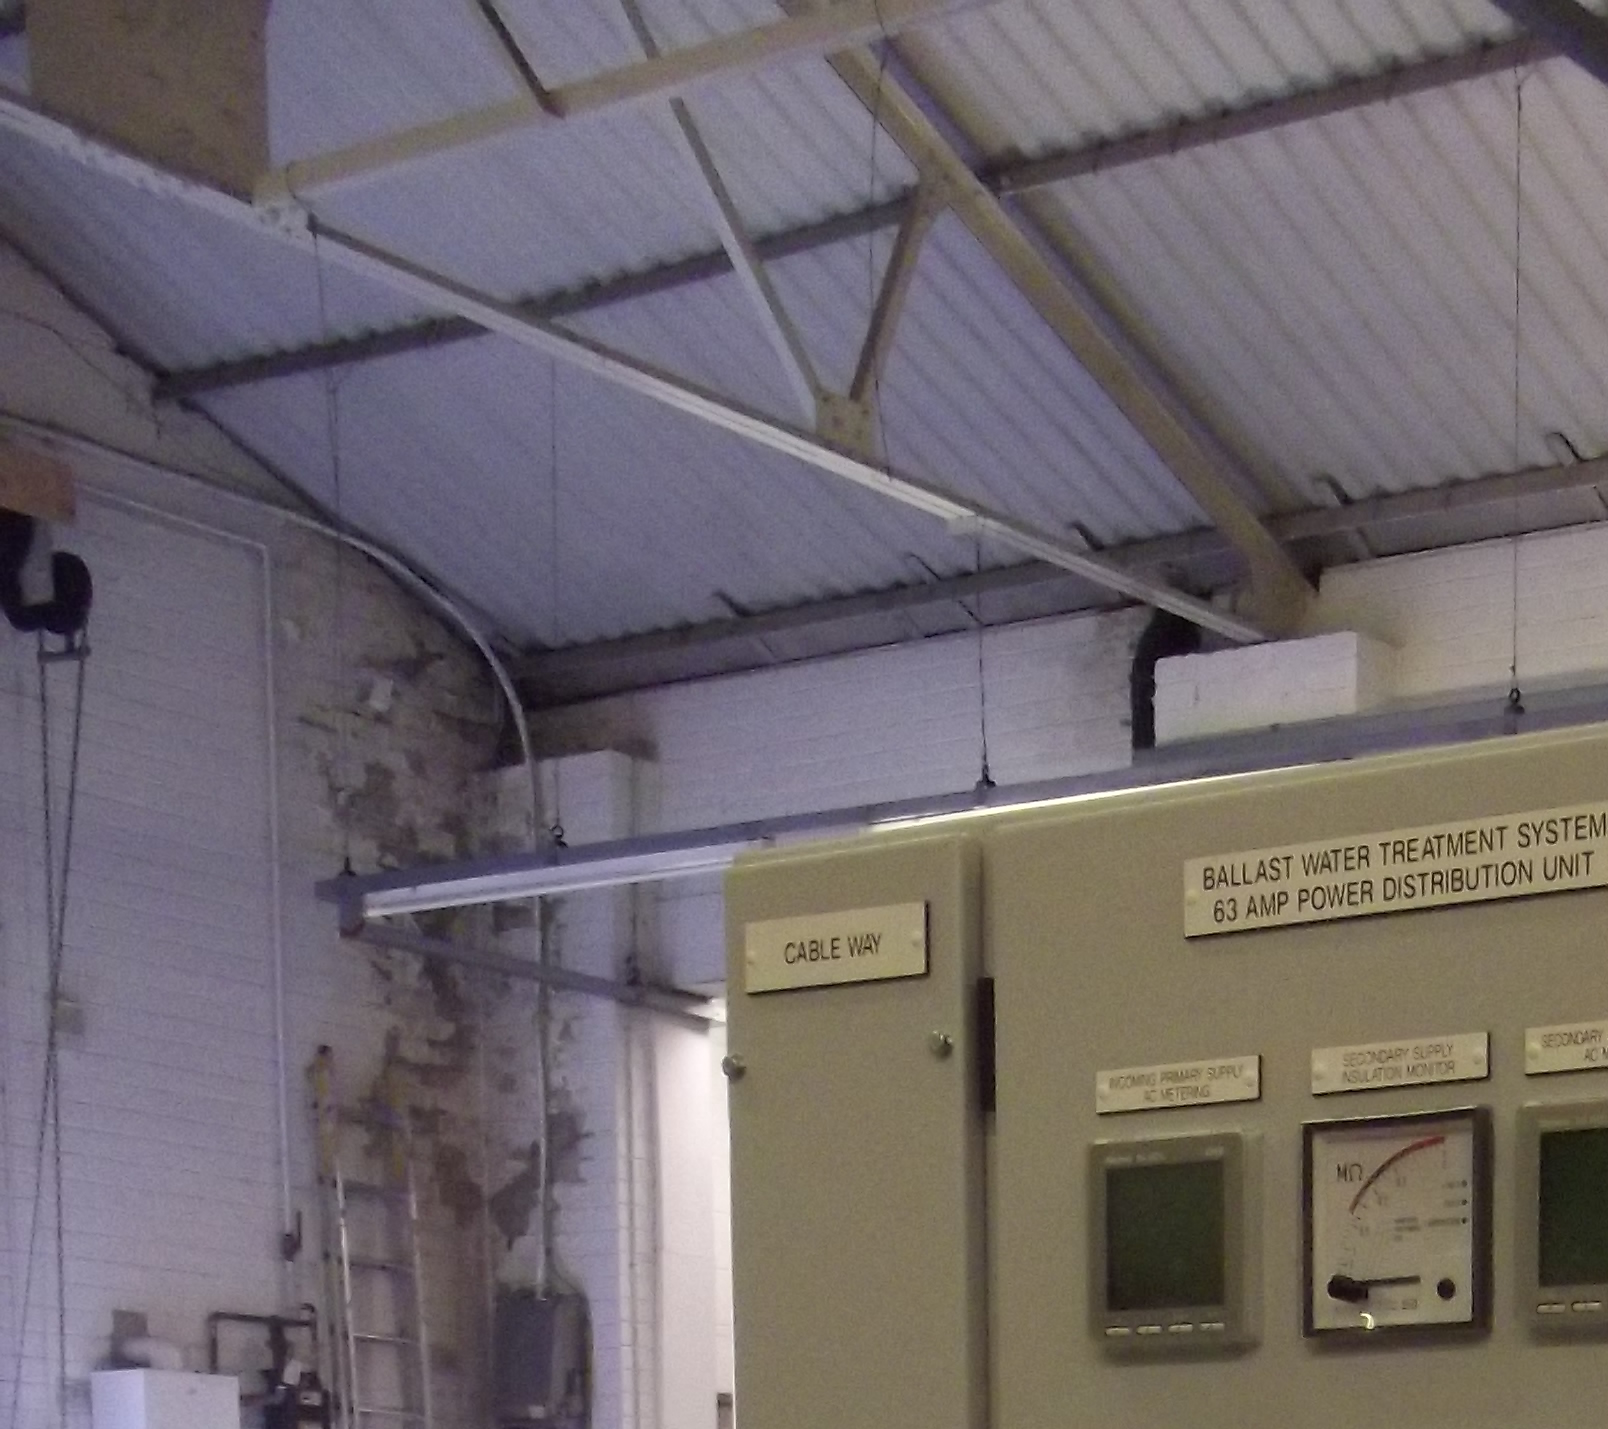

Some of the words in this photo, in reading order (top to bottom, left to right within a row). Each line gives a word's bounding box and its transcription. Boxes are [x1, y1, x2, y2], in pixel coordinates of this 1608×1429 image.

[1202, 854, 1294, 891] BALLAST
[1301, 844, 1371, 879] WATER
[1379, 825, 1508, 867] TREATMENT
[1517, 812, 1607, 849] SYSTEM
[1213, 900, 1237, 924] 63
[1246, 891, 1289, 920] AMP
[1297, 880, 1374, 913] POWER
[1383, 860, 1533, 901] DISTRIBUTION
[1543, 850, 1595, 882] UNIT
[784, 938, 841, 965] CABLE
[847, 932, 882, 958] WAY
[1541, 1029, 1602, 1048] SECONDARY
[1342, 1048, 1409, 1067] SECONDARY
[1413, 1044, 1453, 1060] SUPPLY
[1207, 1063, 1243, 1082] SUPPLY
[1407, 1061, 1456, 1079] MONITOR
